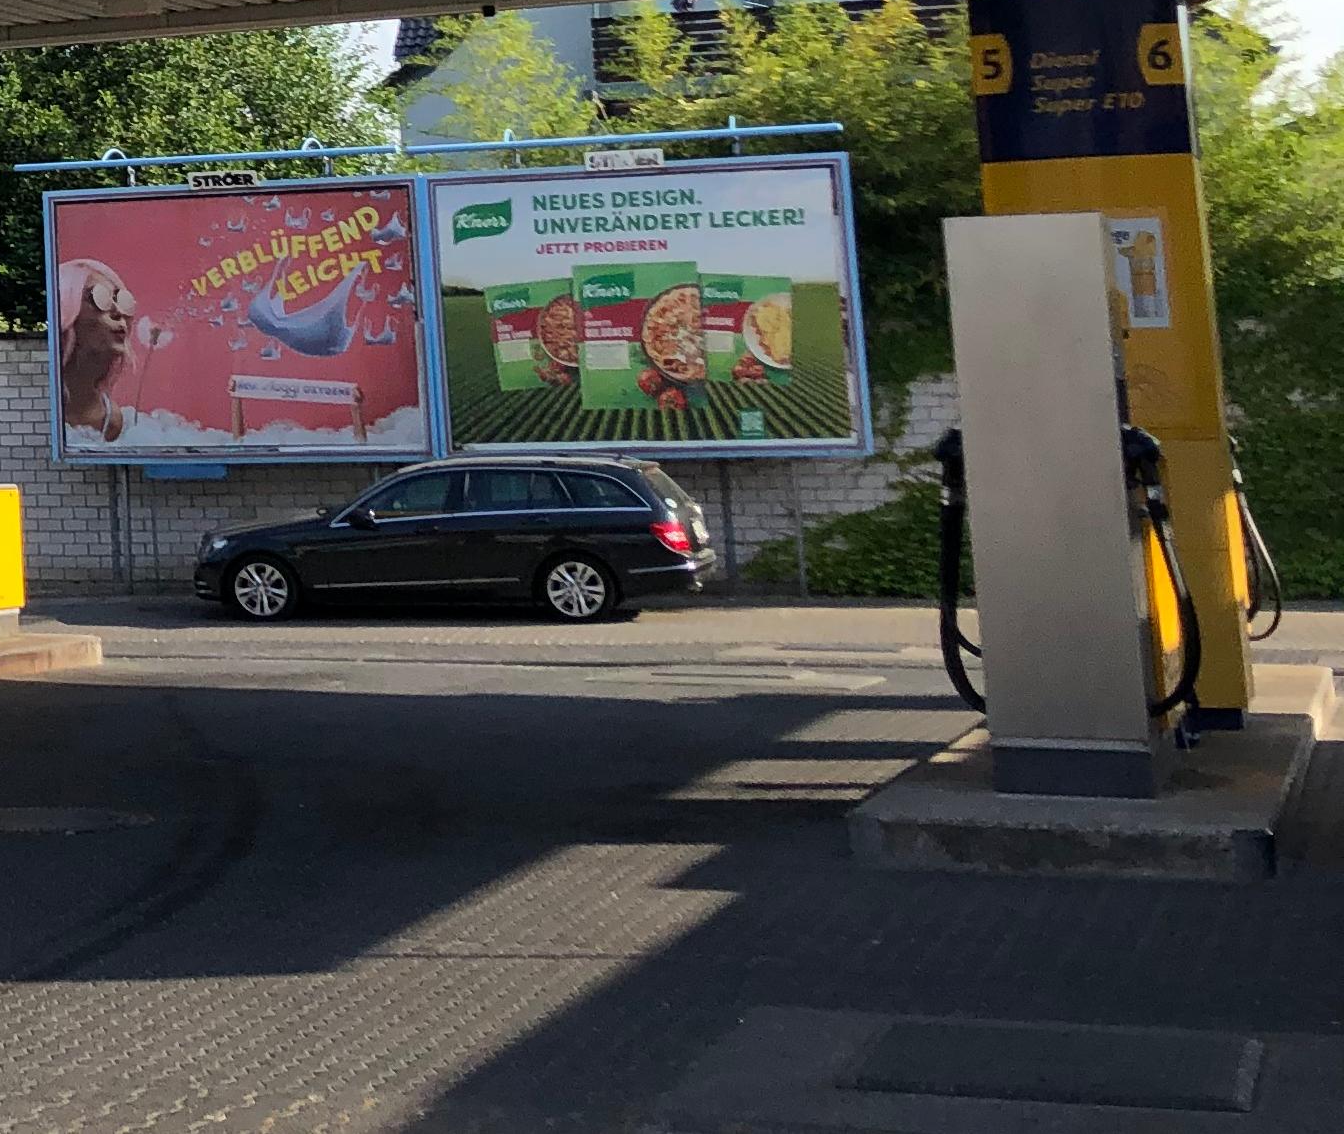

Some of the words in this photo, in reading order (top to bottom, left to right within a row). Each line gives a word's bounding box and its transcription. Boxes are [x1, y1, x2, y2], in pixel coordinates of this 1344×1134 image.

[981, 49, 1002, 80] 5
[1148, 40, 1173, 70] 6
[1029, 74, 1095, 93] Super
[1031, 98, 1096, 116] Super
[1102, 91, 1146, 110] E10
[191, 172, 254, 189] STRÖER
[532, 193, 606, 212] NEUES
[612, 188, 703, 208] DESIGN.
[454, 210, 510, 232] Knorr
[533, 210, 703, 236] UNVERÄNDERT
[709, 207, 805, 229] LECKER!
[192, 205, 380, 297] VERBLÜFFEND
[535, 242, 580, 256] JETZT
[584, 239, 668, 254] PROBIEREN
[275, 250, 381, 301] LEICHT
